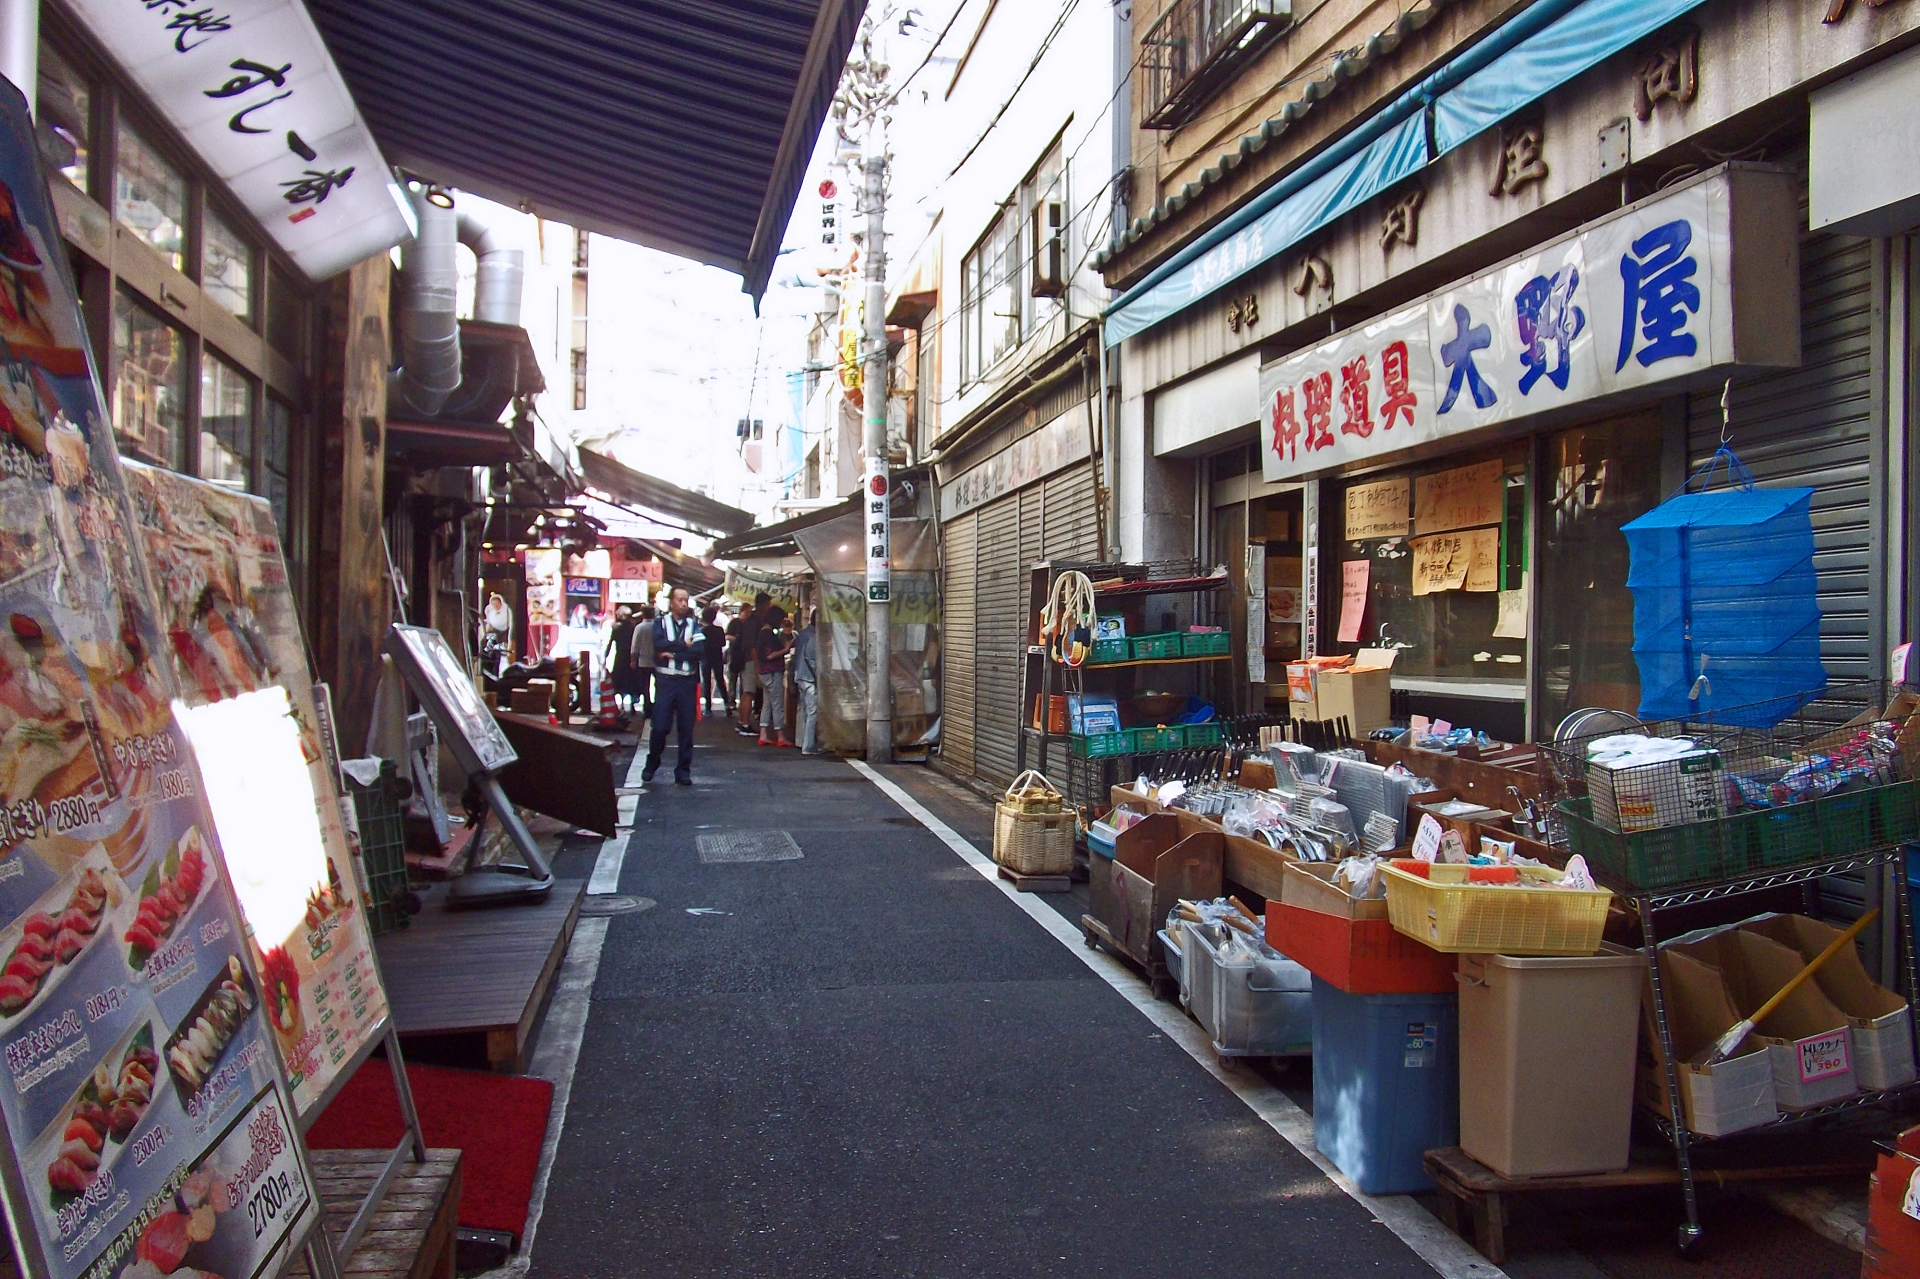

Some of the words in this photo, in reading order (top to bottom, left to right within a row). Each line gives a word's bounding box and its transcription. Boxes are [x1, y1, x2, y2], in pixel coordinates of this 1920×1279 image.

[822, 203, 835, 245] 世界屋
[1190, 225, 1264, 299] 大野屋商店
[1270, 339, 1419, 461] 料理道具
[1436, 218, 1700, 416] 大野屋
[870, 501, 885, 559] 世界屋
[51, 797, 101, 834] 2880円
[86, 987, 121, 1023] 3184円
[132, 1124, 166, 1166] 2300円
[248, 1171, 292, 1239] 2780円
